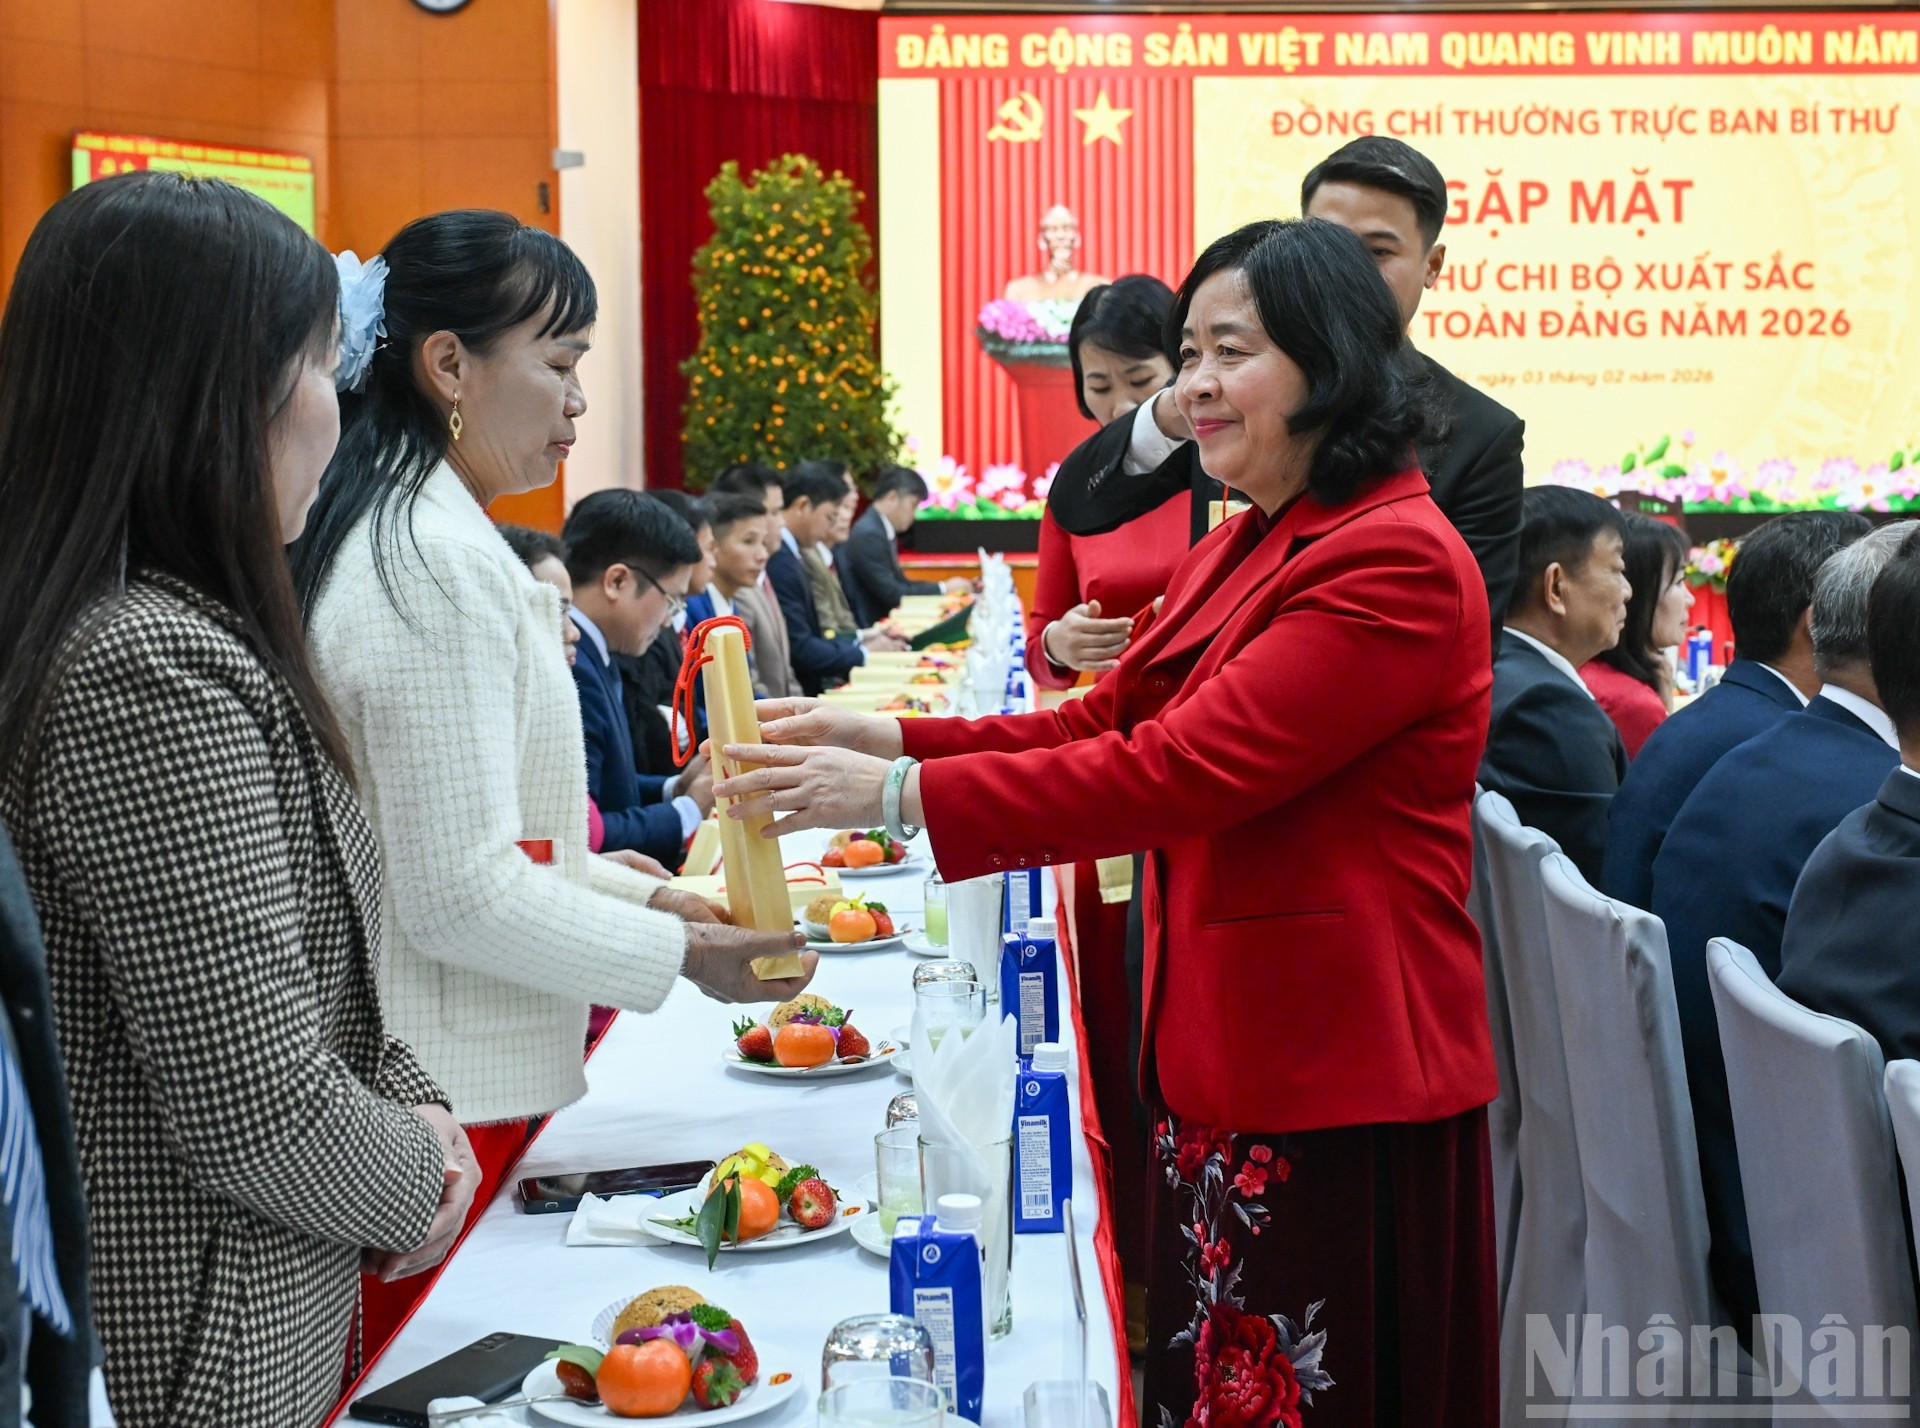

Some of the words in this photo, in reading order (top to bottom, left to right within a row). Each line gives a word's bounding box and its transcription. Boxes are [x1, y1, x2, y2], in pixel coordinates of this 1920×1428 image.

[895, 24, 1009, 69] ĐẢNG
[1020, 27, 1132, 74] CỘNG
[1143, 23, 1228, 67] SẢN
[1238, 26, 1325, 73] VIỆT
[1335, 31, 1430, 66] NAM
[1440, 31, 1576, 69] QUANG
[1585, 31, 1682, 66] VINH
[1692, 25, 1813, 65] MUÔN
[1823, 25, 1919, 65] NĂM
[1271, 99, 1375, 137] ĐỒNG
[1386, 103, 1443, 136] CHÍ
[1453, 104, 1601, 136] THƯỜNG
[1611, 106, 1698, 141] TRỰC
[1709, 109, 1778, 135] BAN
[1790, 102, 1820, 135] BÍ
[1829, 104, 1899, 134] THƯ
[1444, 168, 1549, 238] GẶP
[1570, 168, 1694, 237] MẶT
[1433, 259, 1487, 292] HƯ
[1496, 263, 1558, 292] CHI
[1571, 256, 1623, 299] BỘ
[1635, 250, 1733, 291] XUẤT
[1744, 251, 1815, 291] SẮC
[1422, 302, 1526, 339] TOÀN
[1538, 302, 1648, 338] ĐẢNG
[1661, 301, 1748, 337] NĂM
[1761, 309, 1851, 337] 2026
[1476, 371, 1517, 388] ngày
[1522, 369, 1544, 384] 03
[1549, 369, 1598, 387] tháng
[1603, 369, 1625, 384] 02
[1629, 370, 1666, 383] năm
[1671, 368, 1715, 384] 2026
[1020, 1119, 1048, 1127] Vinamilk
[916, 1293, 949, 1301] Vinamilk
